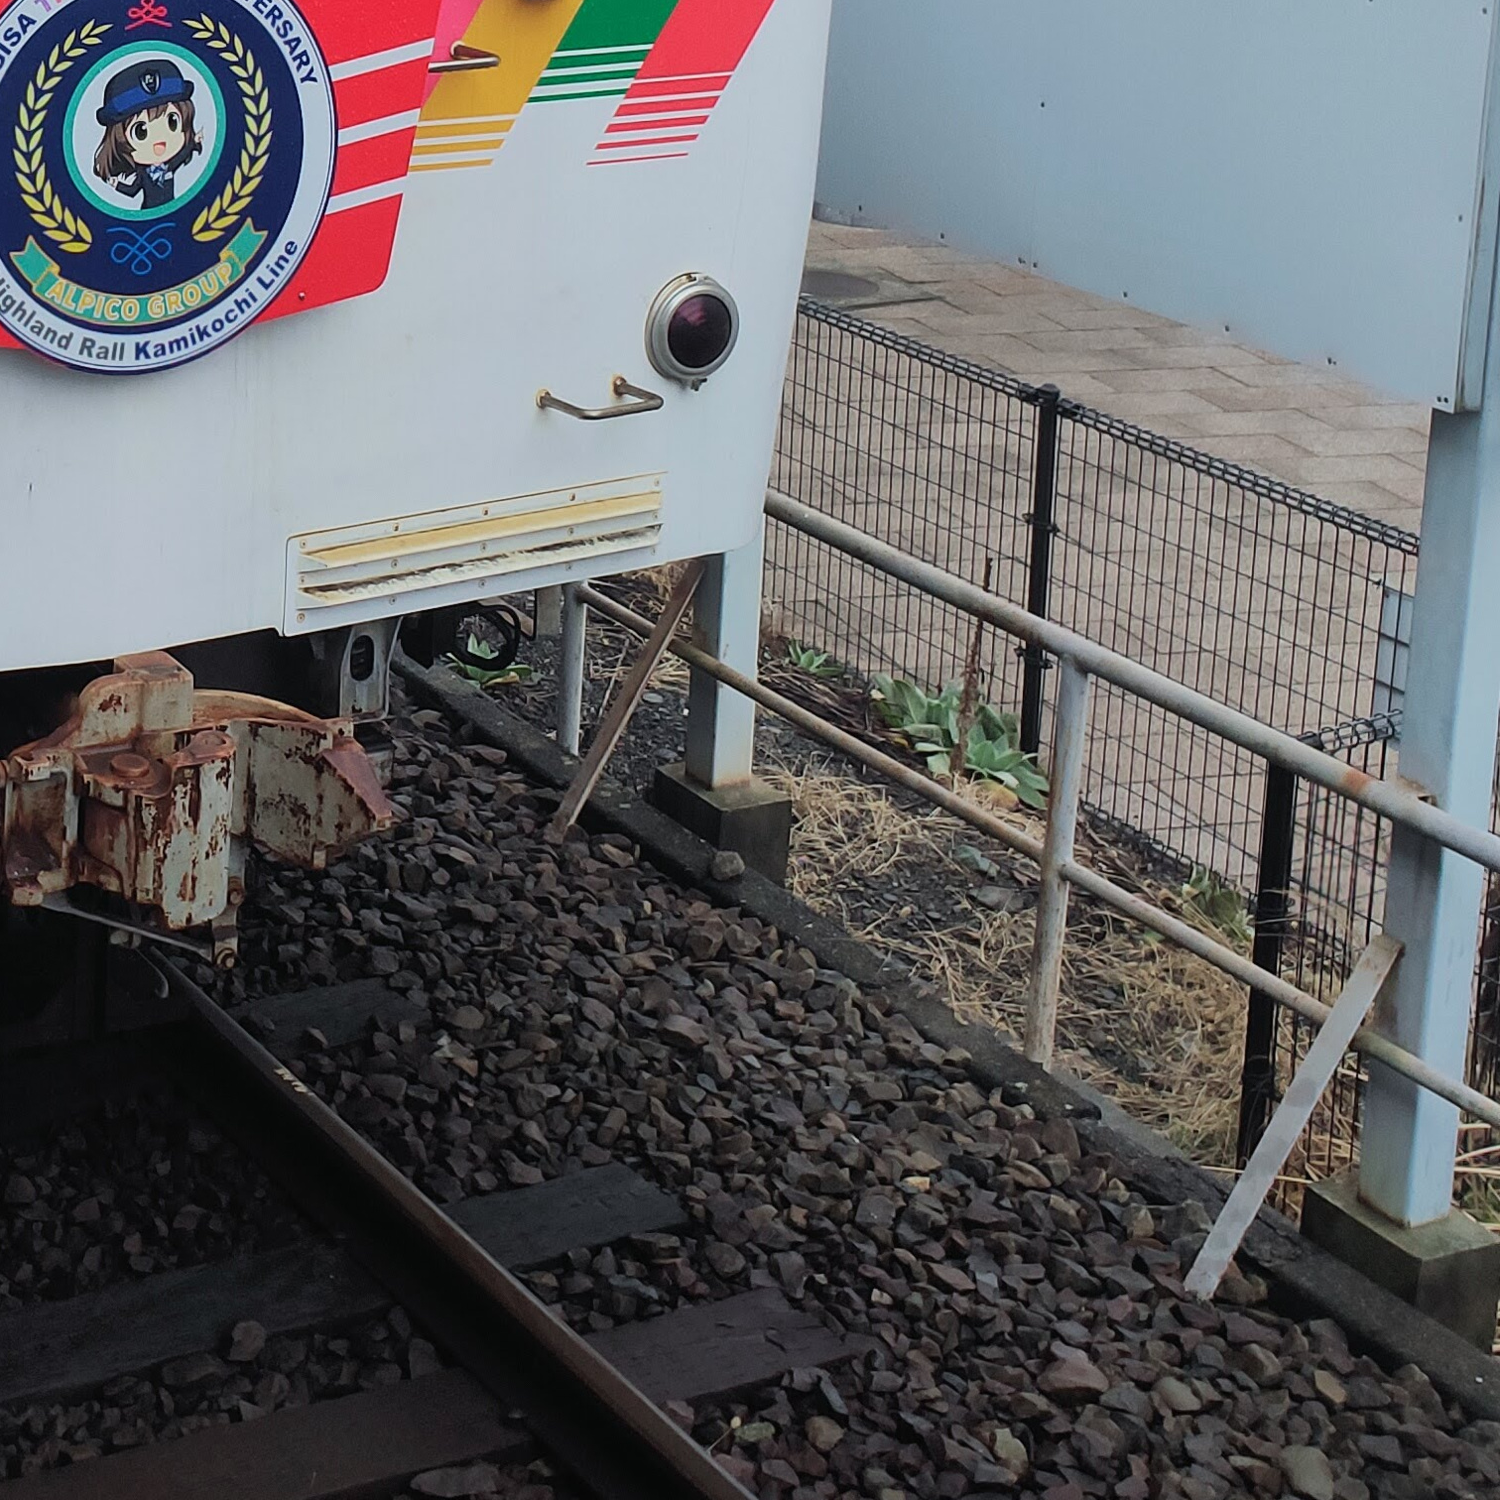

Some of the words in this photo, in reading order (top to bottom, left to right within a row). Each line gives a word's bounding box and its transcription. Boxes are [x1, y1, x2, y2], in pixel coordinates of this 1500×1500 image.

[44, 278, 141, 322] ALPICO
[146, 260, 234, 319] GROUP
[133, 287, 259, 362] Kamikochi
[255, 239, 299, 292] Line
